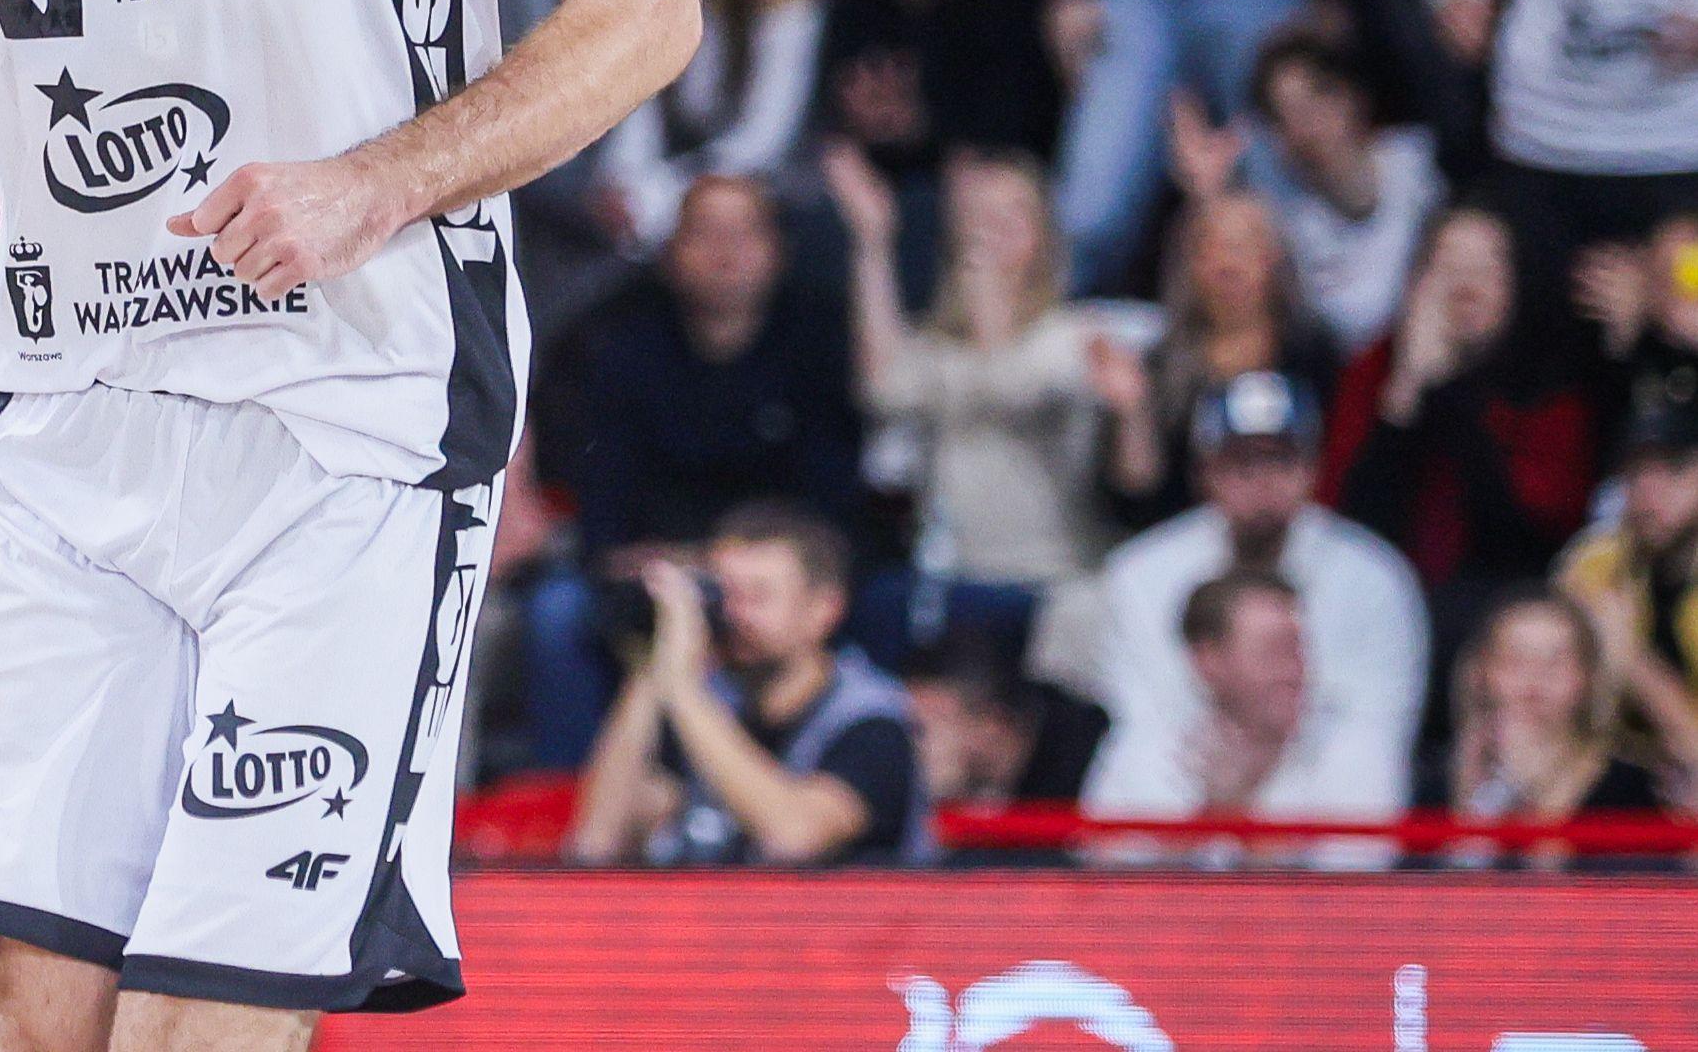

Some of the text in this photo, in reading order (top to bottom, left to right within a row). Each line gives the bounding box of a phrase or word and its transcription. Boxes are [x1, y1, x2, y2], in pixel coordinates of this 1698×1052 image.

[64, 106, 187, 188] LOTTO
[212, 746, 331, 799] LOTTO
[265, 850, 351, 891] 4F
